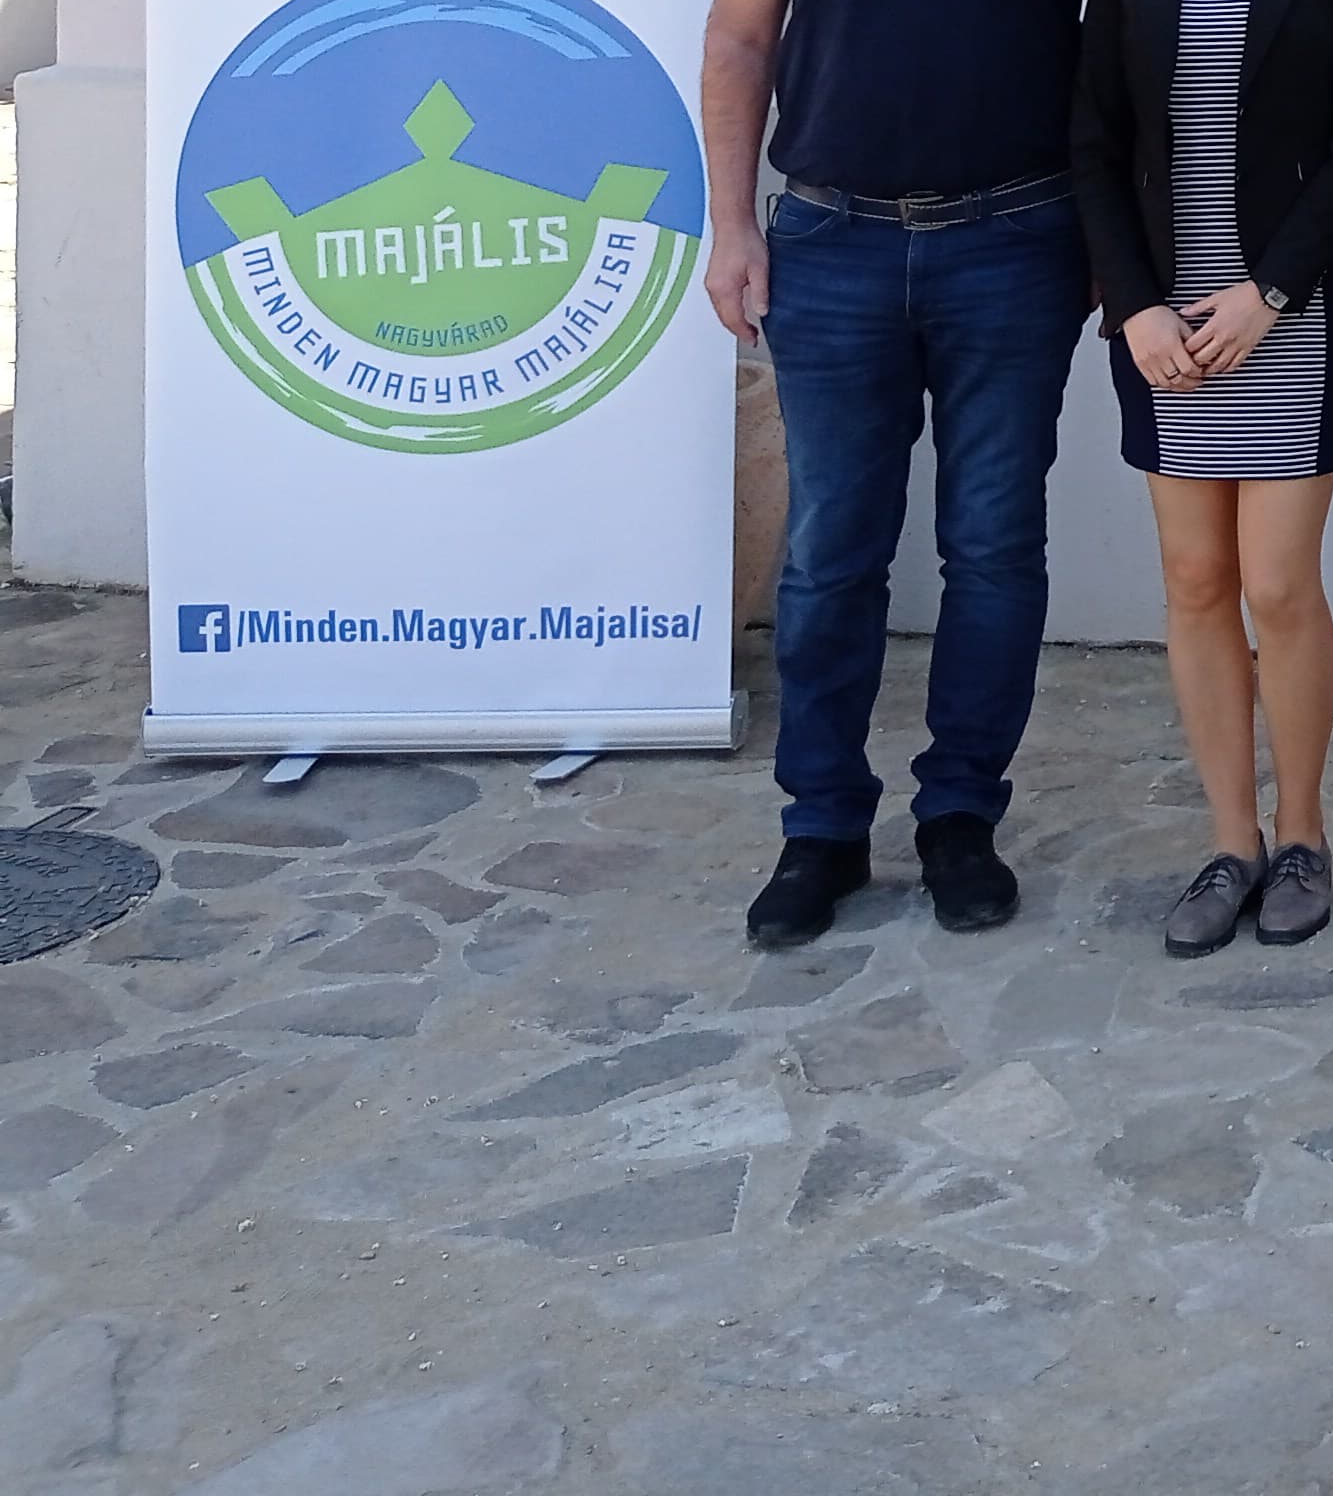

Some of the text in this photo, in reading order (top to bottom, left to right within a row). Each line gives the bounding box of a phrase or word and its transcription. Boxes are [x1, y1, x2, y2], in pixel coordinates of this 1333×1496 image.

[315, 205, 570, 284] MAJÁLIS
[242, 232, 637, 405] MINDEN MAGYAR MAJÁLISA
[375, 313, 510, 349] NAGYVÁRAD
[236, 604, 702, 650] /Minden.Magyar.Majalisa/
